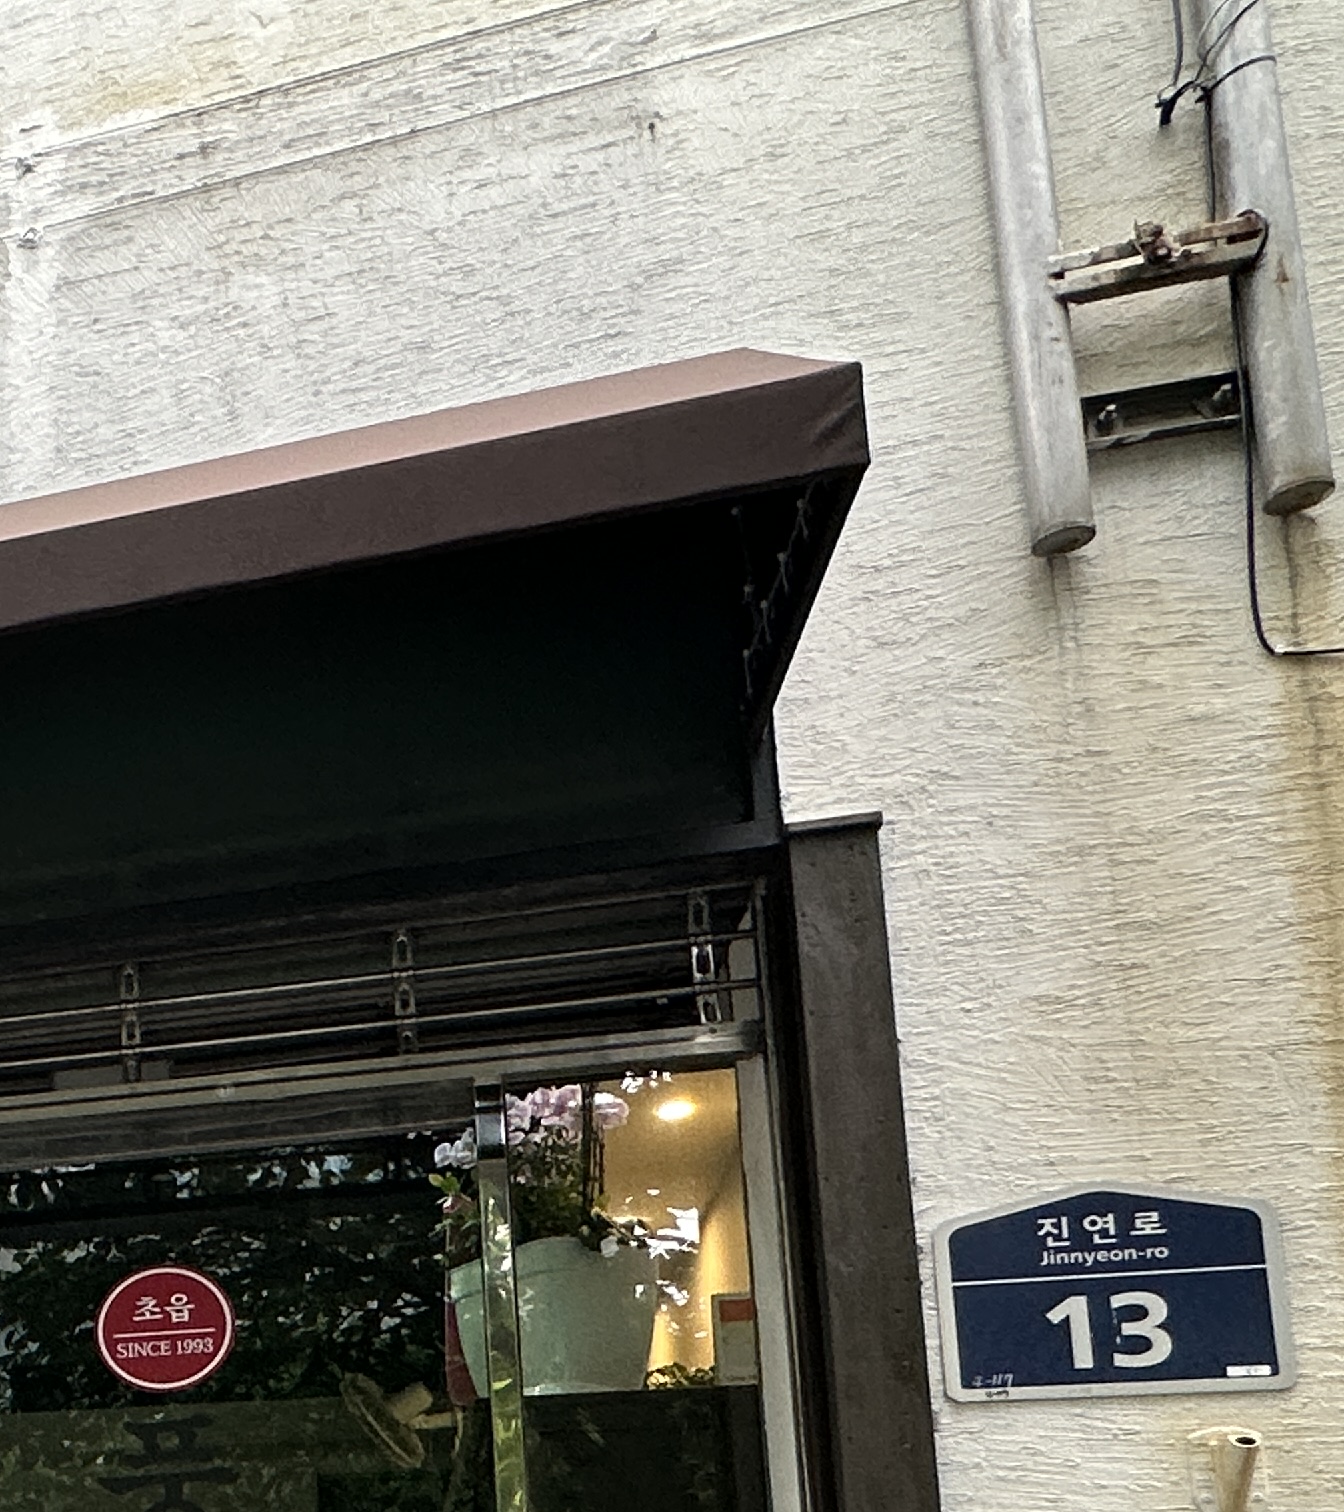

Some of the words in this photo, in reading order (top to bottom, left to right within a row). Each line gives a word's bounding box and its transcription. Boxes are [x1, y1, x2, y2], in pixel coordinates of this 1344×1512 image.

[1037, 1211, 1167, 1248] 진연로
[1041, 1246, 1169, 1267] Jinnyeon-ro
[132, 1293, 195, 1323] 초읍
[1045, 1290, 1173, 1370] 13
[116, 1341, 172, 1359] SINCE
[176, 1338, 214, 1356] 1993
